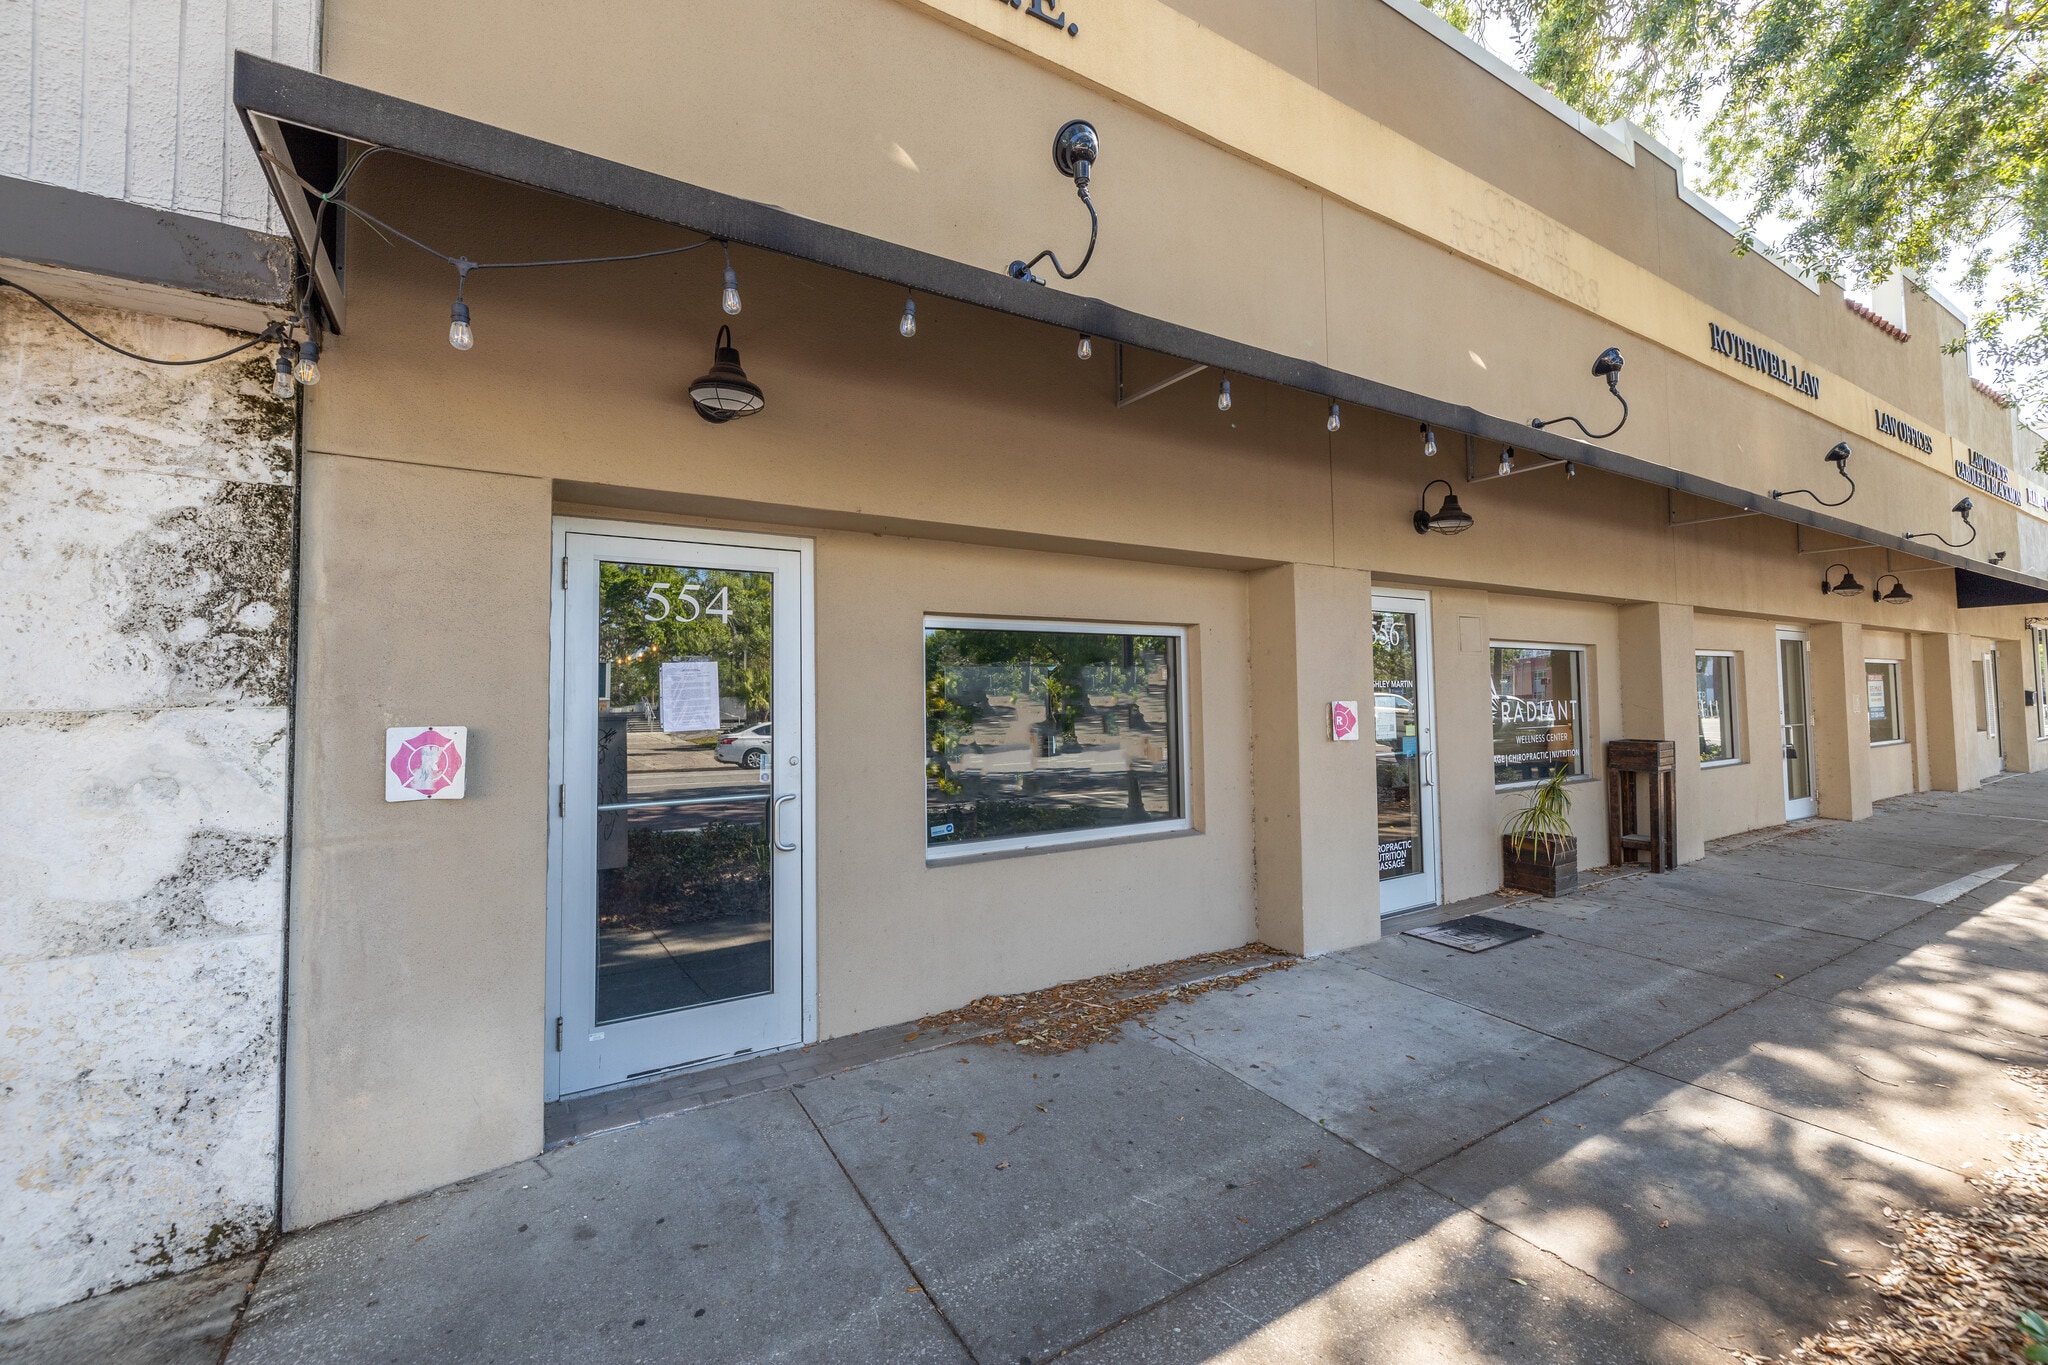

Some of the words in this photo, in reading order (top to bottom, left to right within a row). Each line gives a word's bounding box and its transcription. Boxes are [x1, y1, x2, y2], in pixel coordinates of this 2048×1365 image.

[1709, 322, 1793, 386] ROTHWELL
[1792, 365, 1820, 400] LAW
[1875, 409, 1896, 437] LAW
[1897, 421, 1933, 455] OFFICES
[644, 582, 734, 624] 554
[1391, 680, 1413, 688] MARTIN
[1501, 699, 1577, 723] RADIANT
[1516, 733, 1546, 744] WELLNESS
[1546, 732, 1568, 742] CENTER
